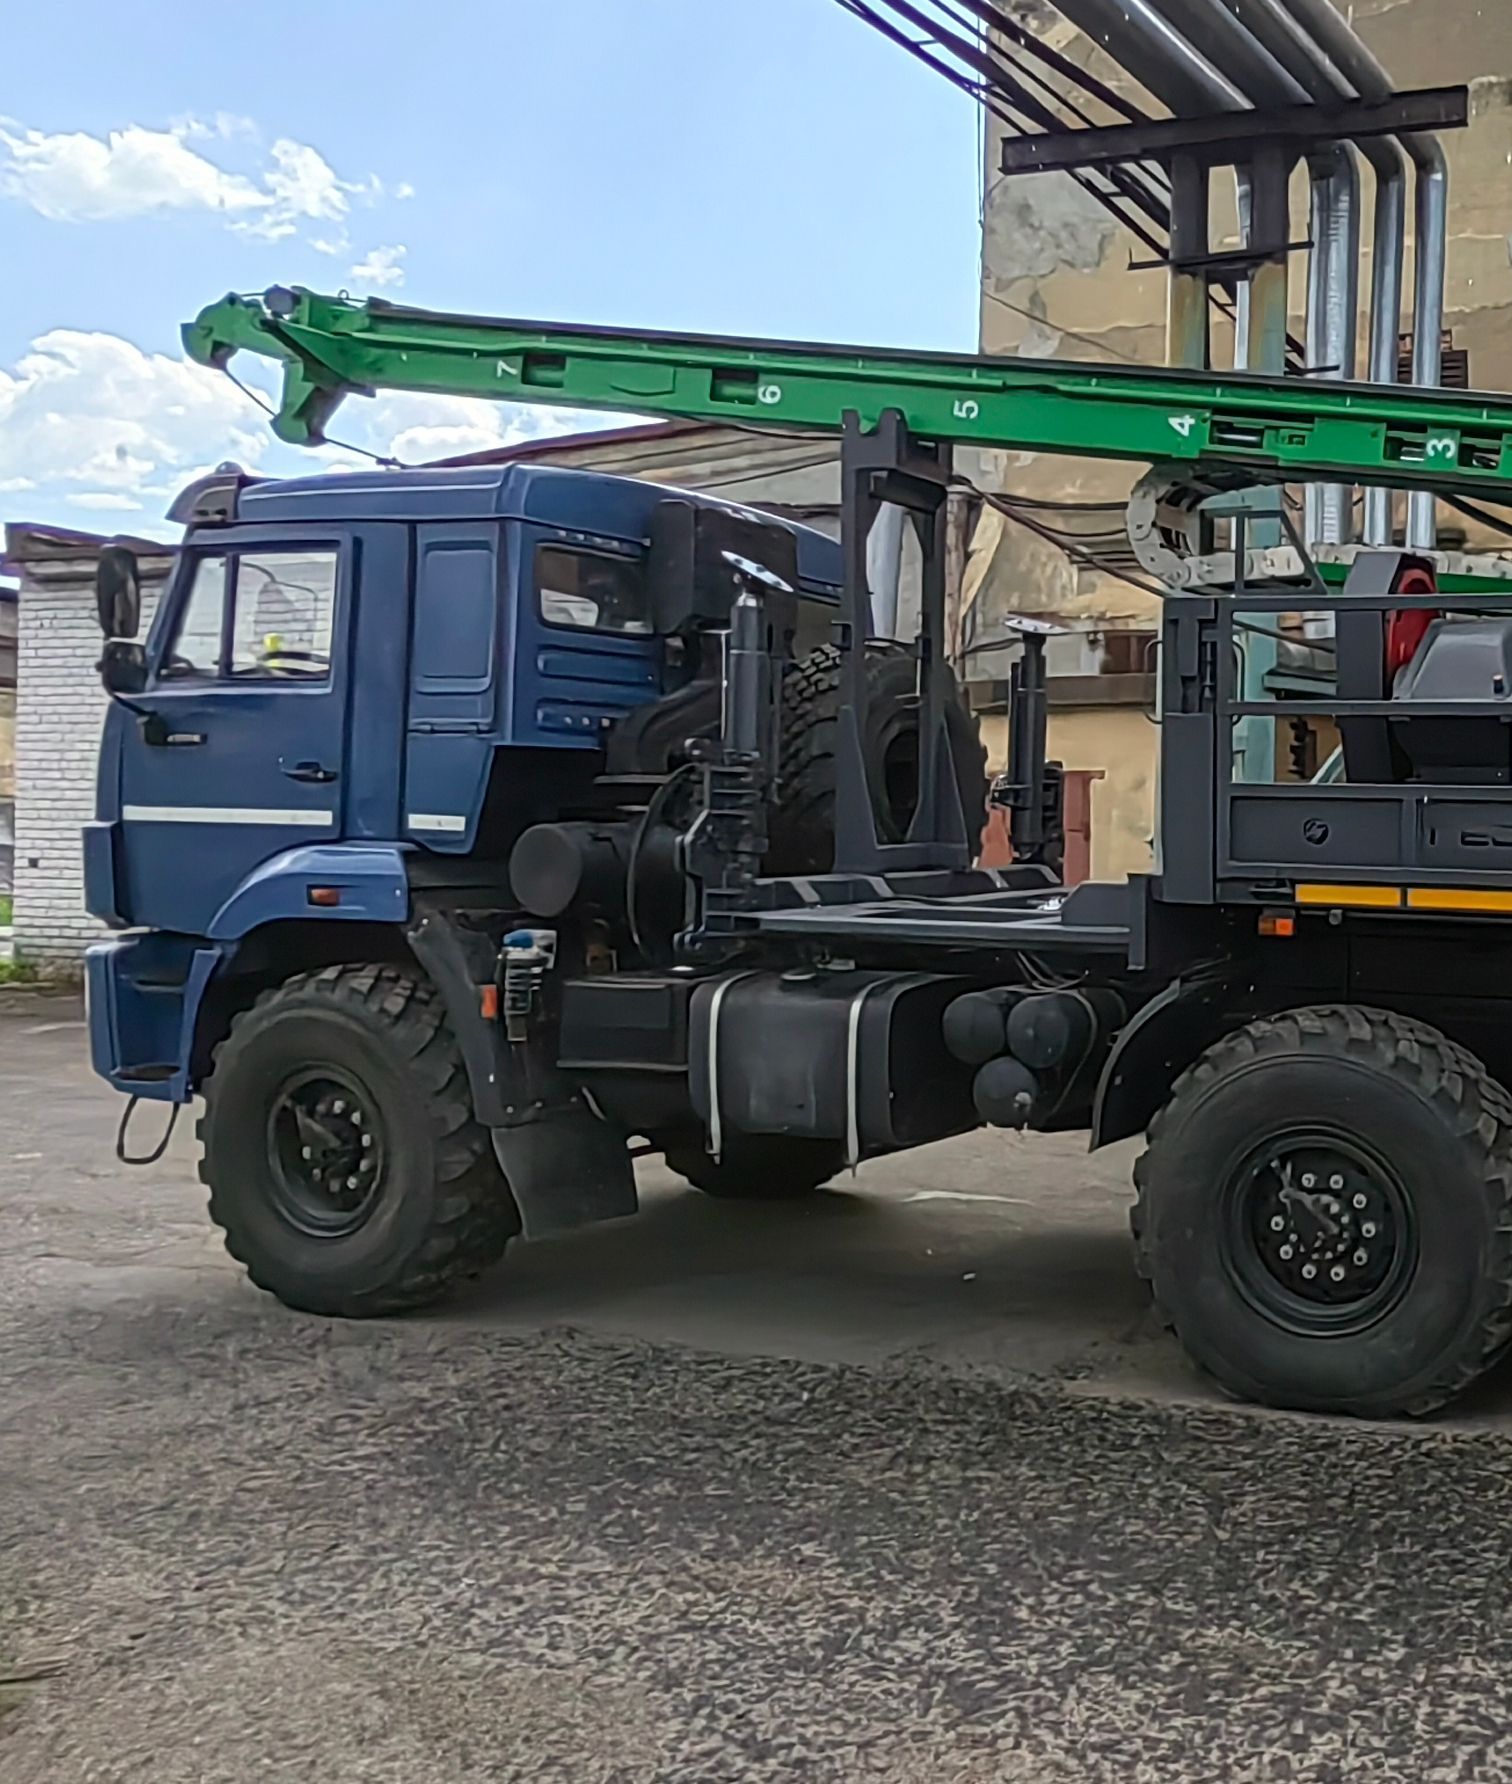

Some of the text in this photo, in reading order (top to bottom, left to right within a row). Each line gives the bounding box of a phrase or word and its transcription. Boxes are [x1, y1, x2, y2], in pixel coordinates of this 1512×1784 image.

[496, 360, 519, 378] 7
[758, 385, 781, 404] 6
[953, 400, 979, 419] 5
[1167, 414, 1196, 437] 4
[1426, 438, 1456, 459] 3
